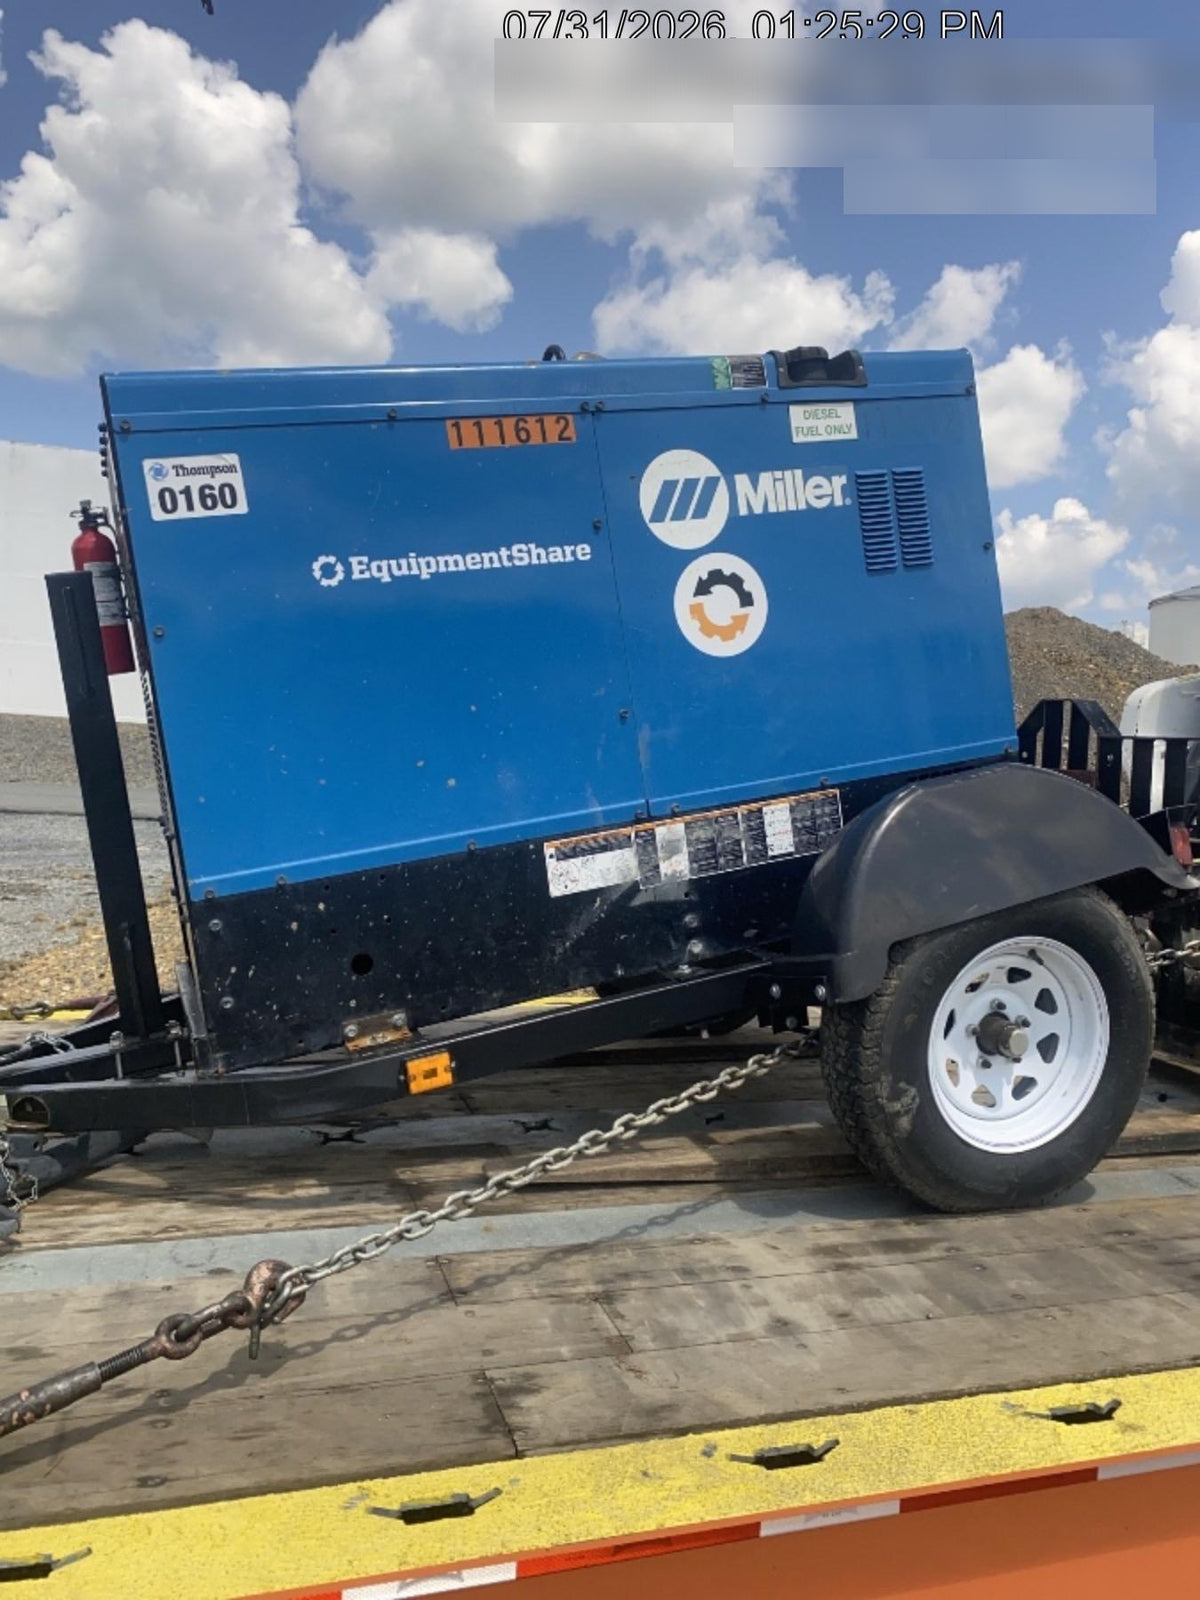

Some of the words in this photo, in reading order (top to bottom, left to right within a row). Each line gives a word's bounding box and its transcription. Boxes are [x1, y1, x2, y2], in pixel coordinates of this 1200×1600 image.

[803, 408, 841, 420] DIESEL
[451, 416, 573, 447] 111612
[794, 425, 822, 437] FUEL
[825, 423, 852, 436] ONLY
[172, 463, 238, 479] Thompson
[158, 482, 238, 514] 0160
[348, 543, 592, 583] EquipmentShare
